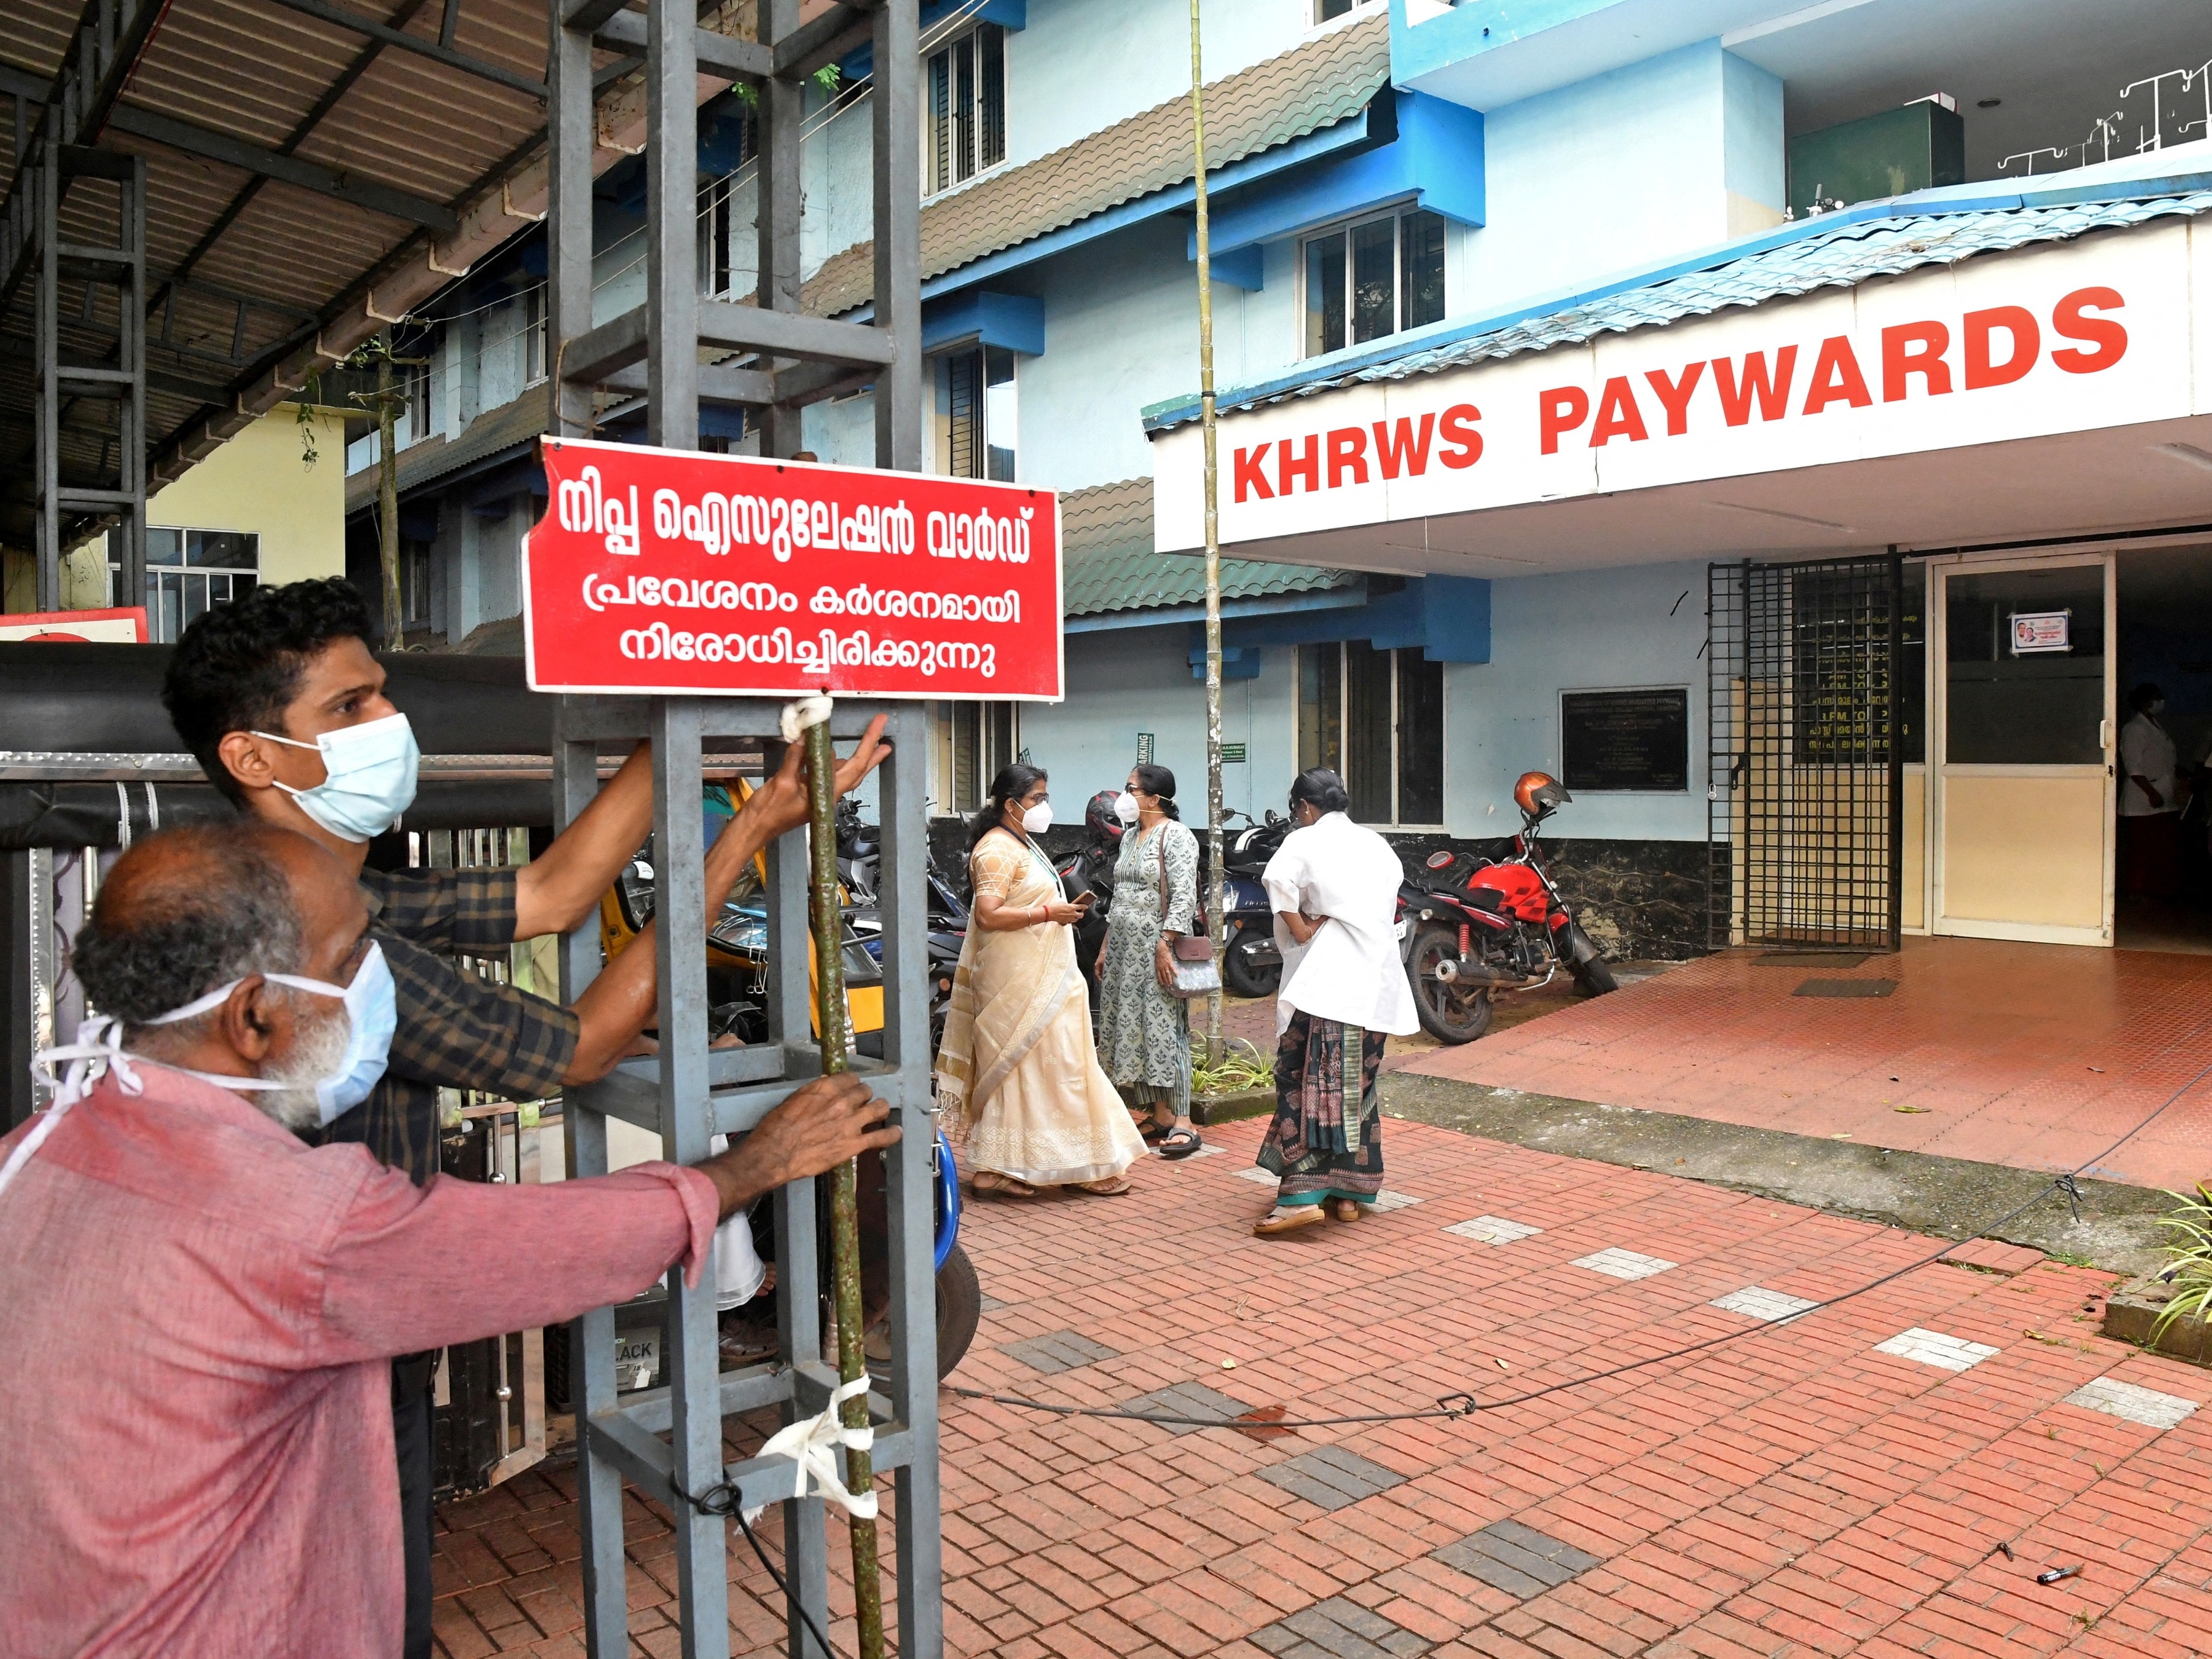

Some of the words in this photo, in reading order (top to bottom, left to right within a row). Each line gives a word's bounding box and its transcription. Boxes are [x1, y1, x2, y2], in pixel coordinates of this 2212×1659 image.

[1234, 404, 1483, 503] KHRWS
[1541, 288, 2127, 455] PAYWARDS
[558, 465, 641, 556] നിപ്പ
[654, 488, 915, 562] ഐസുലേഷൻ
[927, 506, 1034, 564] വാർഡ്
[583, 573, 798, 612] പ്രവേശനം
[810, 583, 1020, 623] കർശനമായി
[620, 621, 996, 678] നിരോധിച്ചിരിക്കുന്നു
[1138, 735, 1148, 764] ARKING
[616, 1342, 652, 1361] ACK
